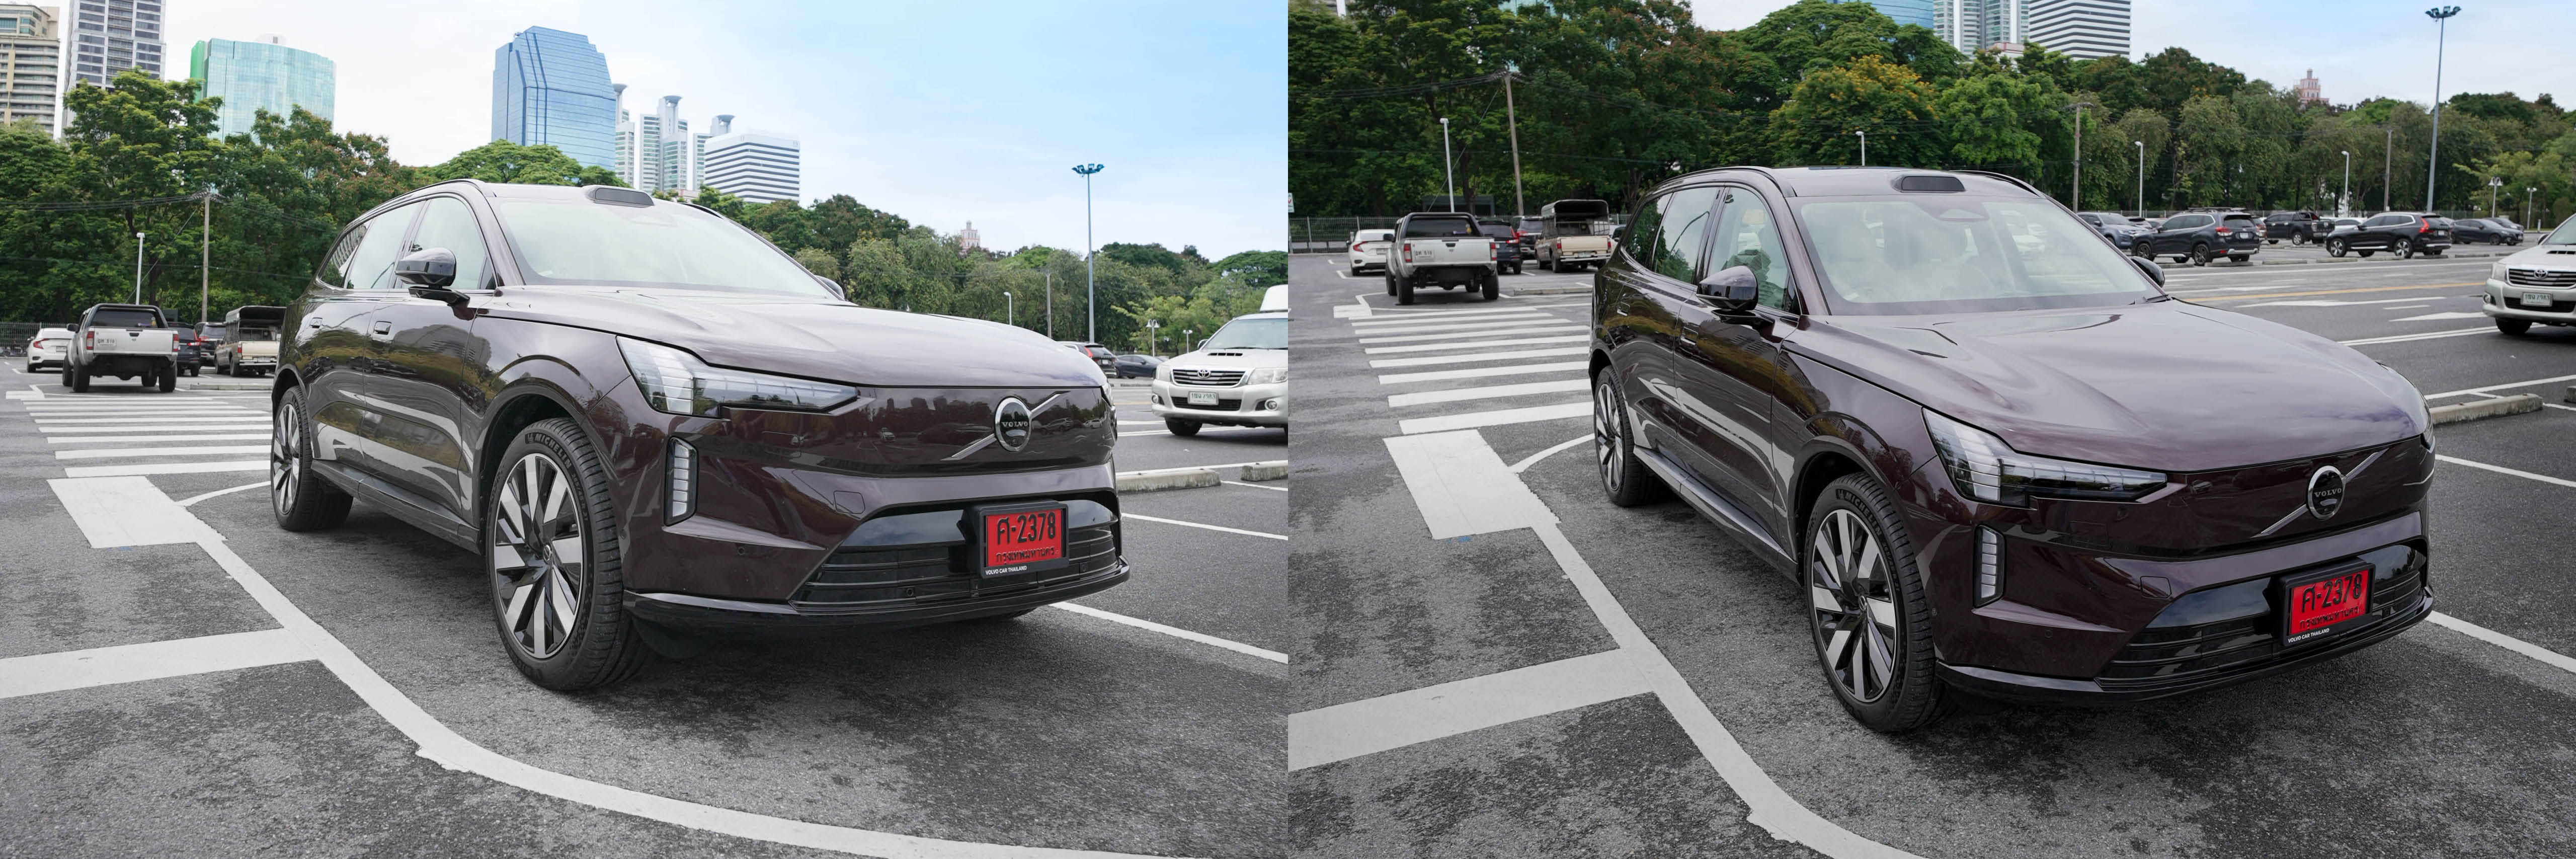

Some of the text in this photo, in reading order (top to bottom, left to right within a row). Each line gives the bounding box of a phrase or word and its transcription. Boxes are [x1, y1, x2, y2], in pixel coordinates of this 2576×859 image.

[535, 433, 572, 468] MICHELIN
[2314, 488, 2342, 497] VOLVO
[1845, 492, 1882, 536] MICHELIN
[2310, 628, 2329, 637] THAILAND
